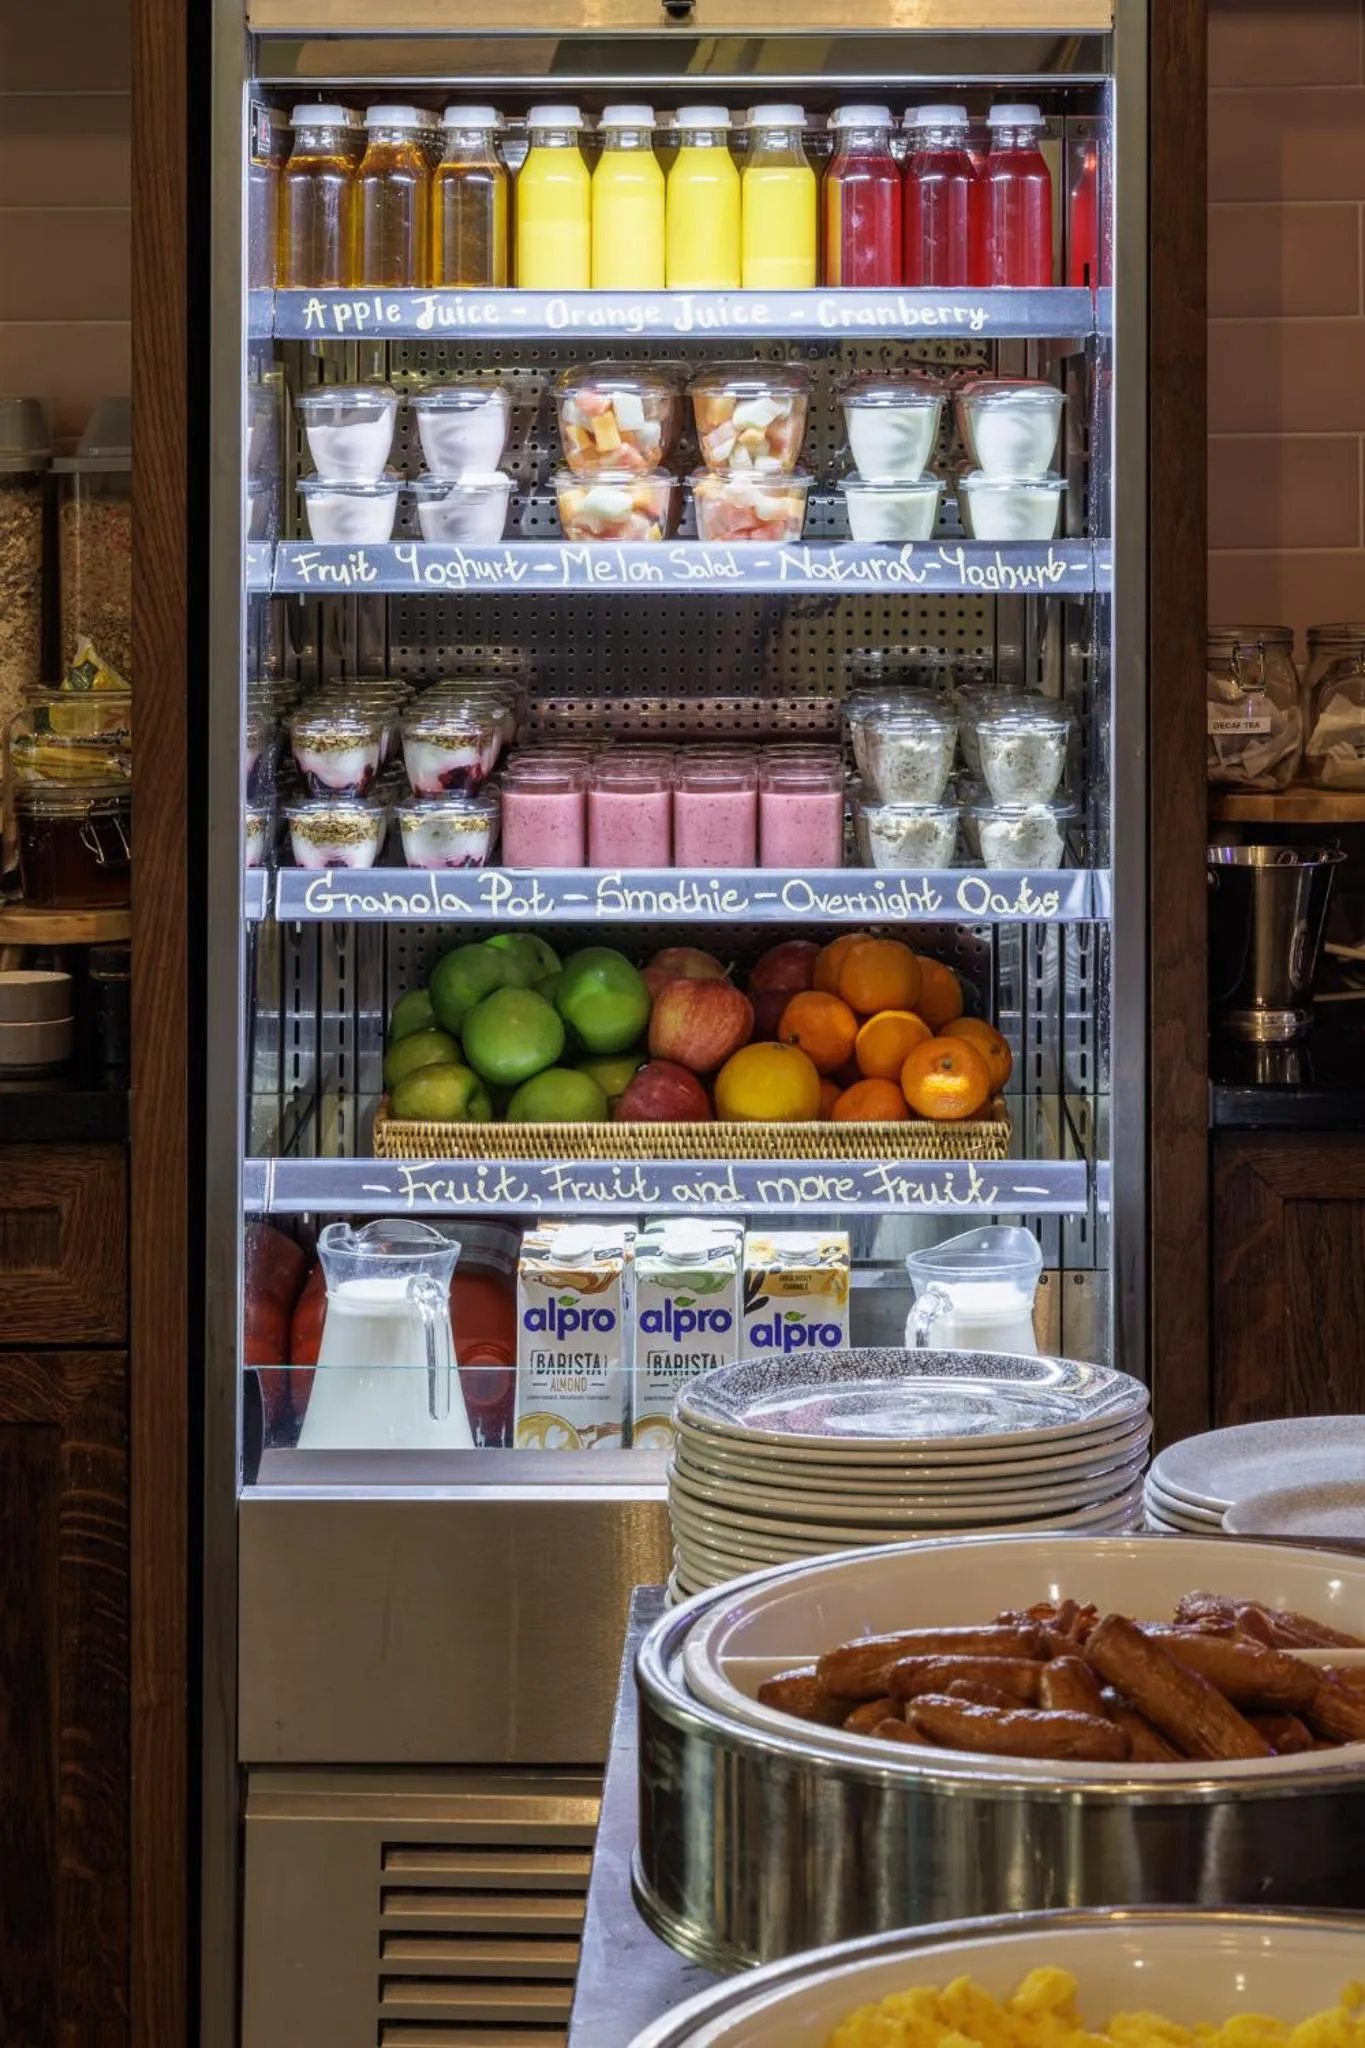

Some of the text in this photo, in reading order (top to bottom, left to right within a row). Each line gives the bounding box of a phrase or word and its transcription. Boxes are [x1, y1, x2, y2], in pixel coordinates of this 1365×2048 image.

[302, 297, 402, 332] Apple
[410, 294, 501, 330] Juice
[545, 299, 662, 333] Orange
[672, 295, 770, 331] Juice
[817, 294, 990, 330] Cranberry
[291, 551, 378, 586] Fruit
[394, 545, 528, 590] Yoghurt
[560, 547, 664, 587] Melon
[669, 550, 745, 579] Salad
[778, 543, 924, 584] Natural
[1244, 721, 1261, 729] TEA
[305, 870, 473, 915] Granola
[478, 871, 556, 917] Pot
[596, 870, 749, 917] Smothie
[781, 877, 942, 919] Overnight
[956, 875, 1060, 918] Oats
[397, 1161, 542, 1208] Fruit,
[541, 1161, 661, 1202] Fruit
[671, 1164, 746, 1205] and
[756, 1176, 863, 1208] more
[863, 1160, 999, 1208] Fruit
[523, 1297, 616, 1341] alpro
[639, 1297, 733, 1342] alpro
[749, 1313, 843, 1353] alpro
[536, 1353, 602, 1376] BARISTA
[550, 1377, 588, 1392] ALMOND
[653, 1353, 719, 1377] BARISTA
